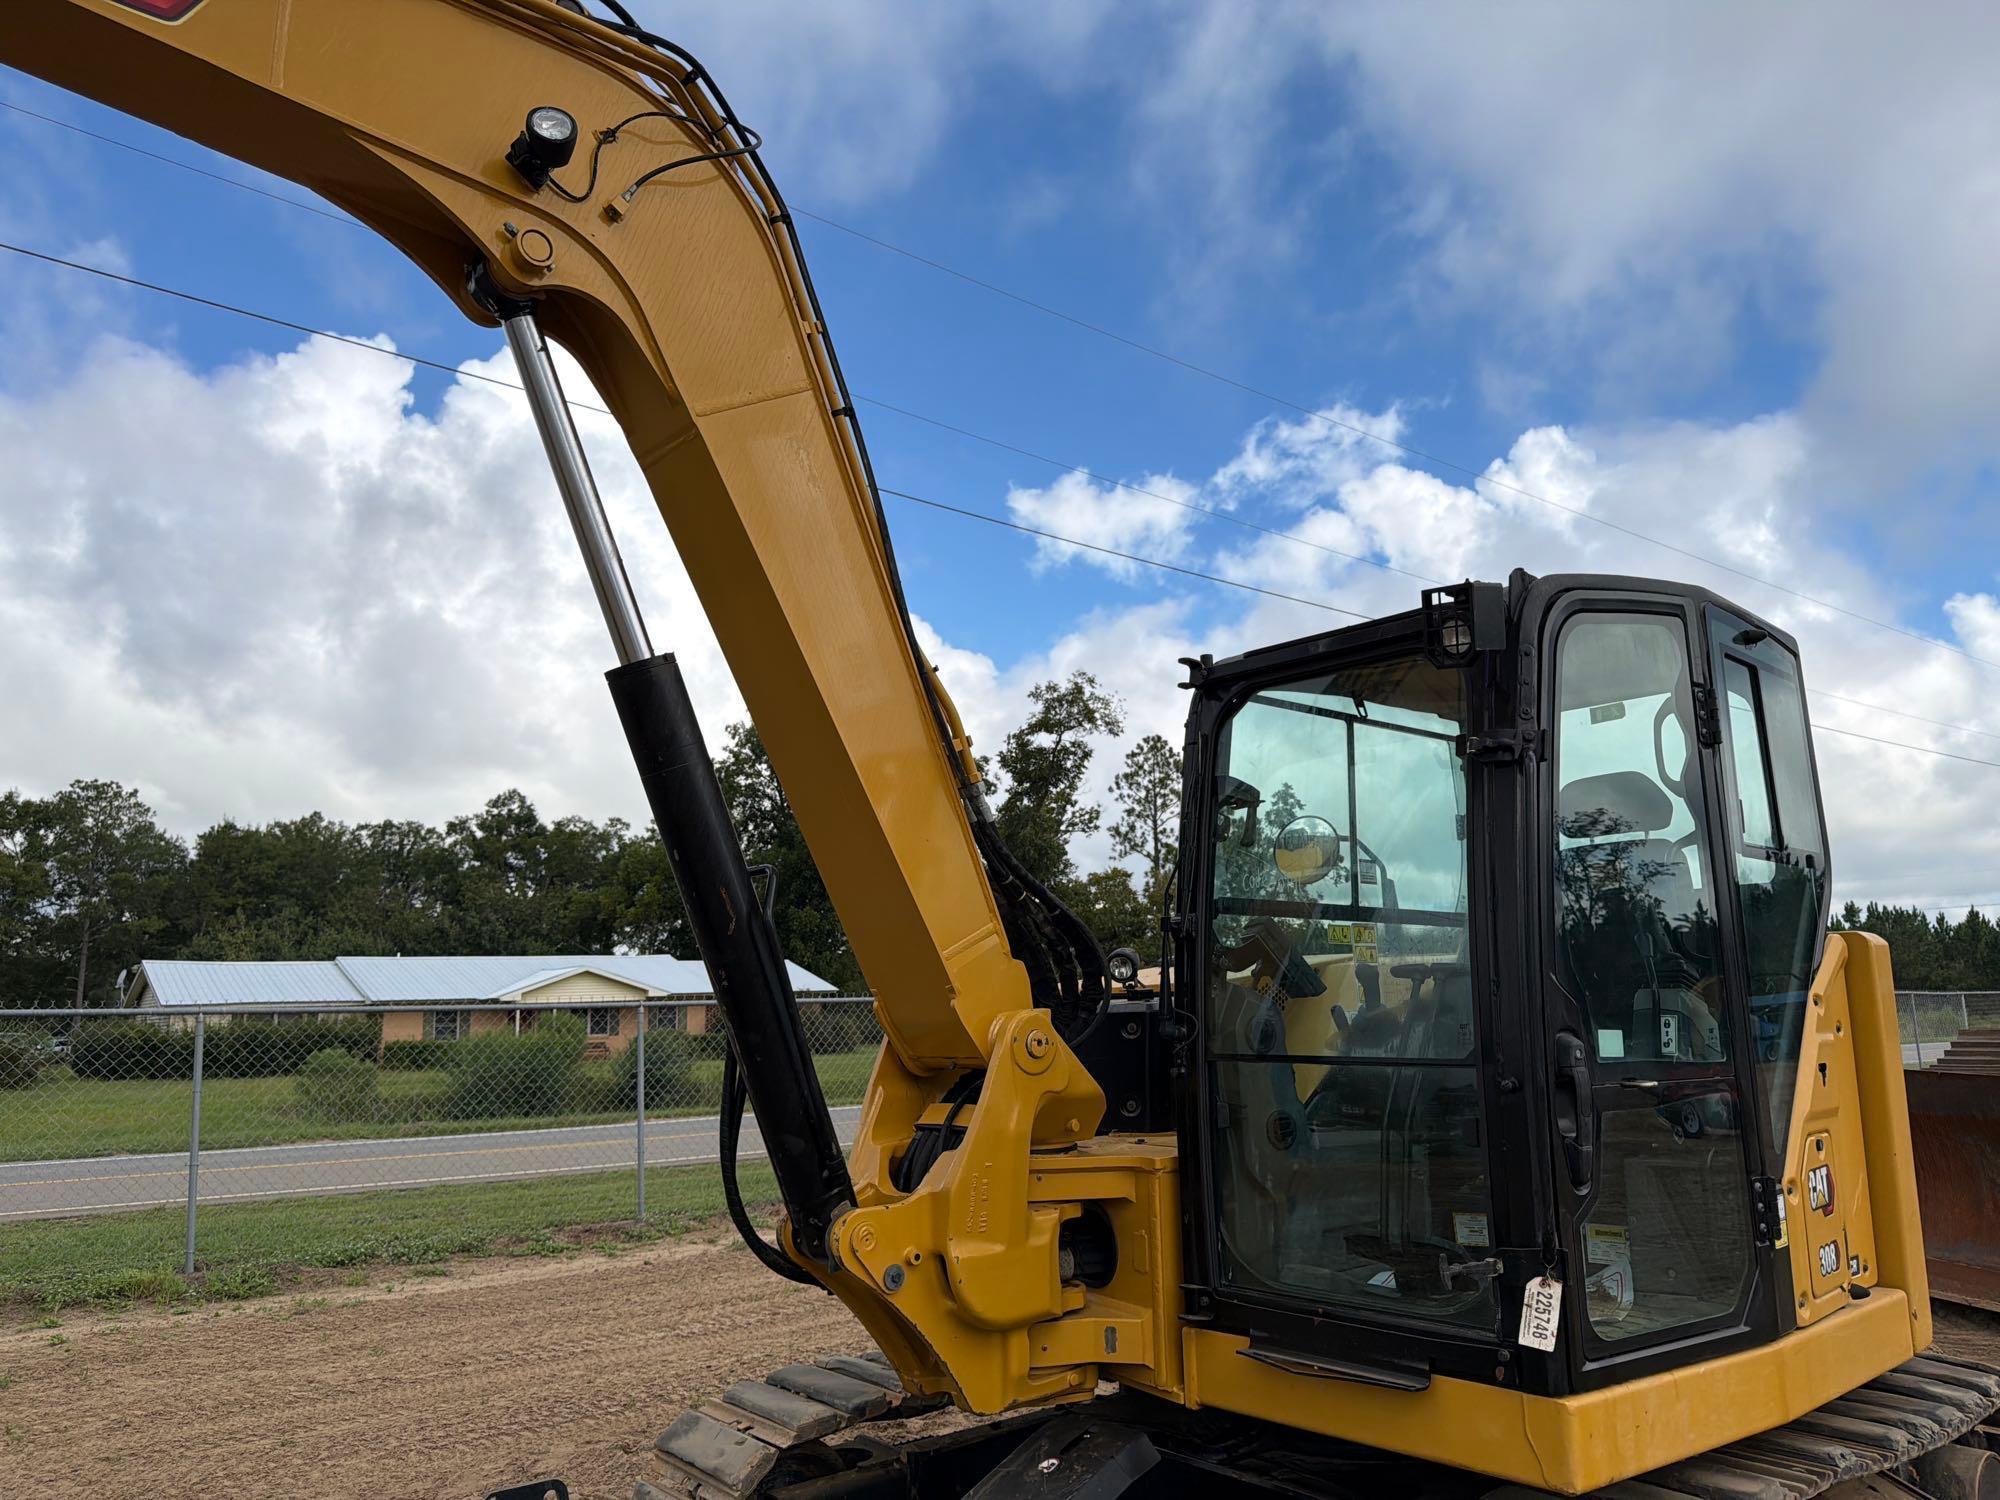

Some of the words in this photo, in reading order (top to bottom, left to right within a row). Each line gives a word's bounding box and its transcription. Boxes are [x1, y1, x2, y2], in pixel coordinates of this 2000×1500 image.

[1808, 1166, 1830, 1210] CAT
[1819, 1242, 1837, 1276] 308
[1532, 1291, 1553, 1340] 225748
